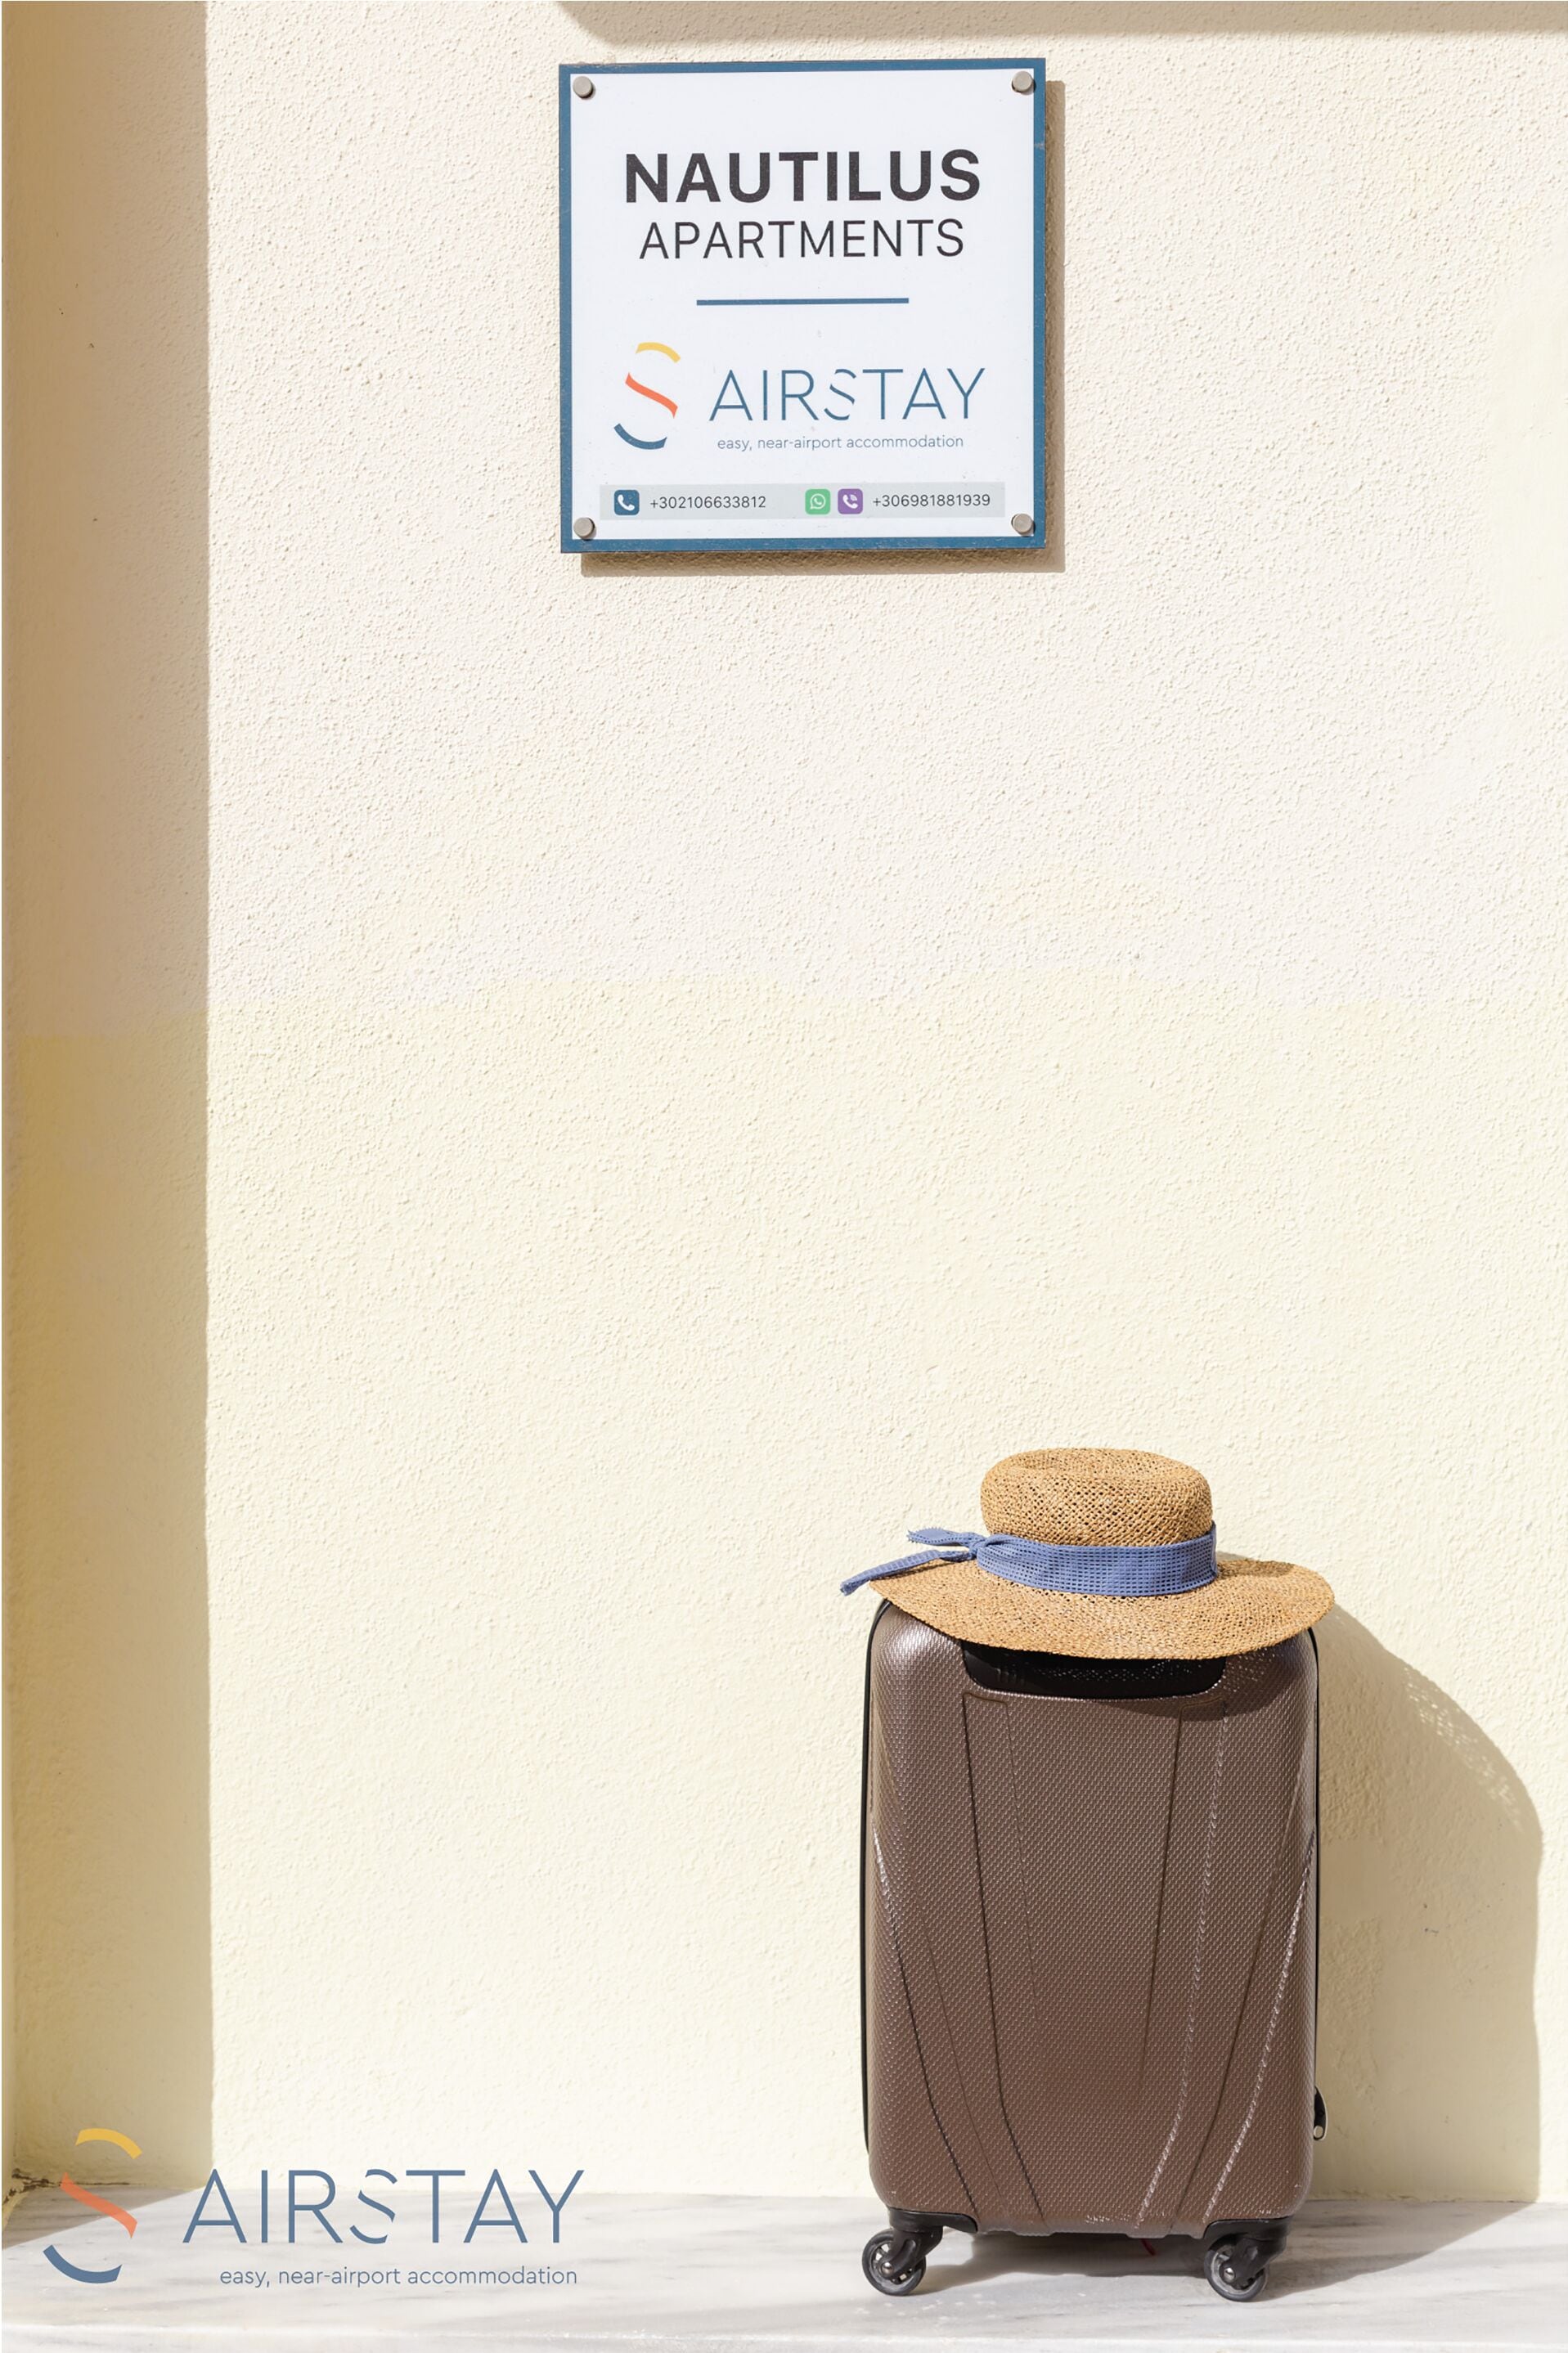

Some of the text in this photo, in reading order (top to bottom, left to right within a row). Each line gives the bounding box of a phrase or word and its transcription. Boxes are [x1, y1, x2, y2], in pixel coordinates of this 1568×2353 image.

[626, 149, 981, 203] NAUTILUS
[639, 218, 964, 259] APARTMENTS
[709, 367, 986, 421] AIRSTAY
[717, 434, 964, 452] easy, near-airport accommodation
[649, 496, 766, 509] +302106633812
[873, 493, 991, 507] +306981881939
